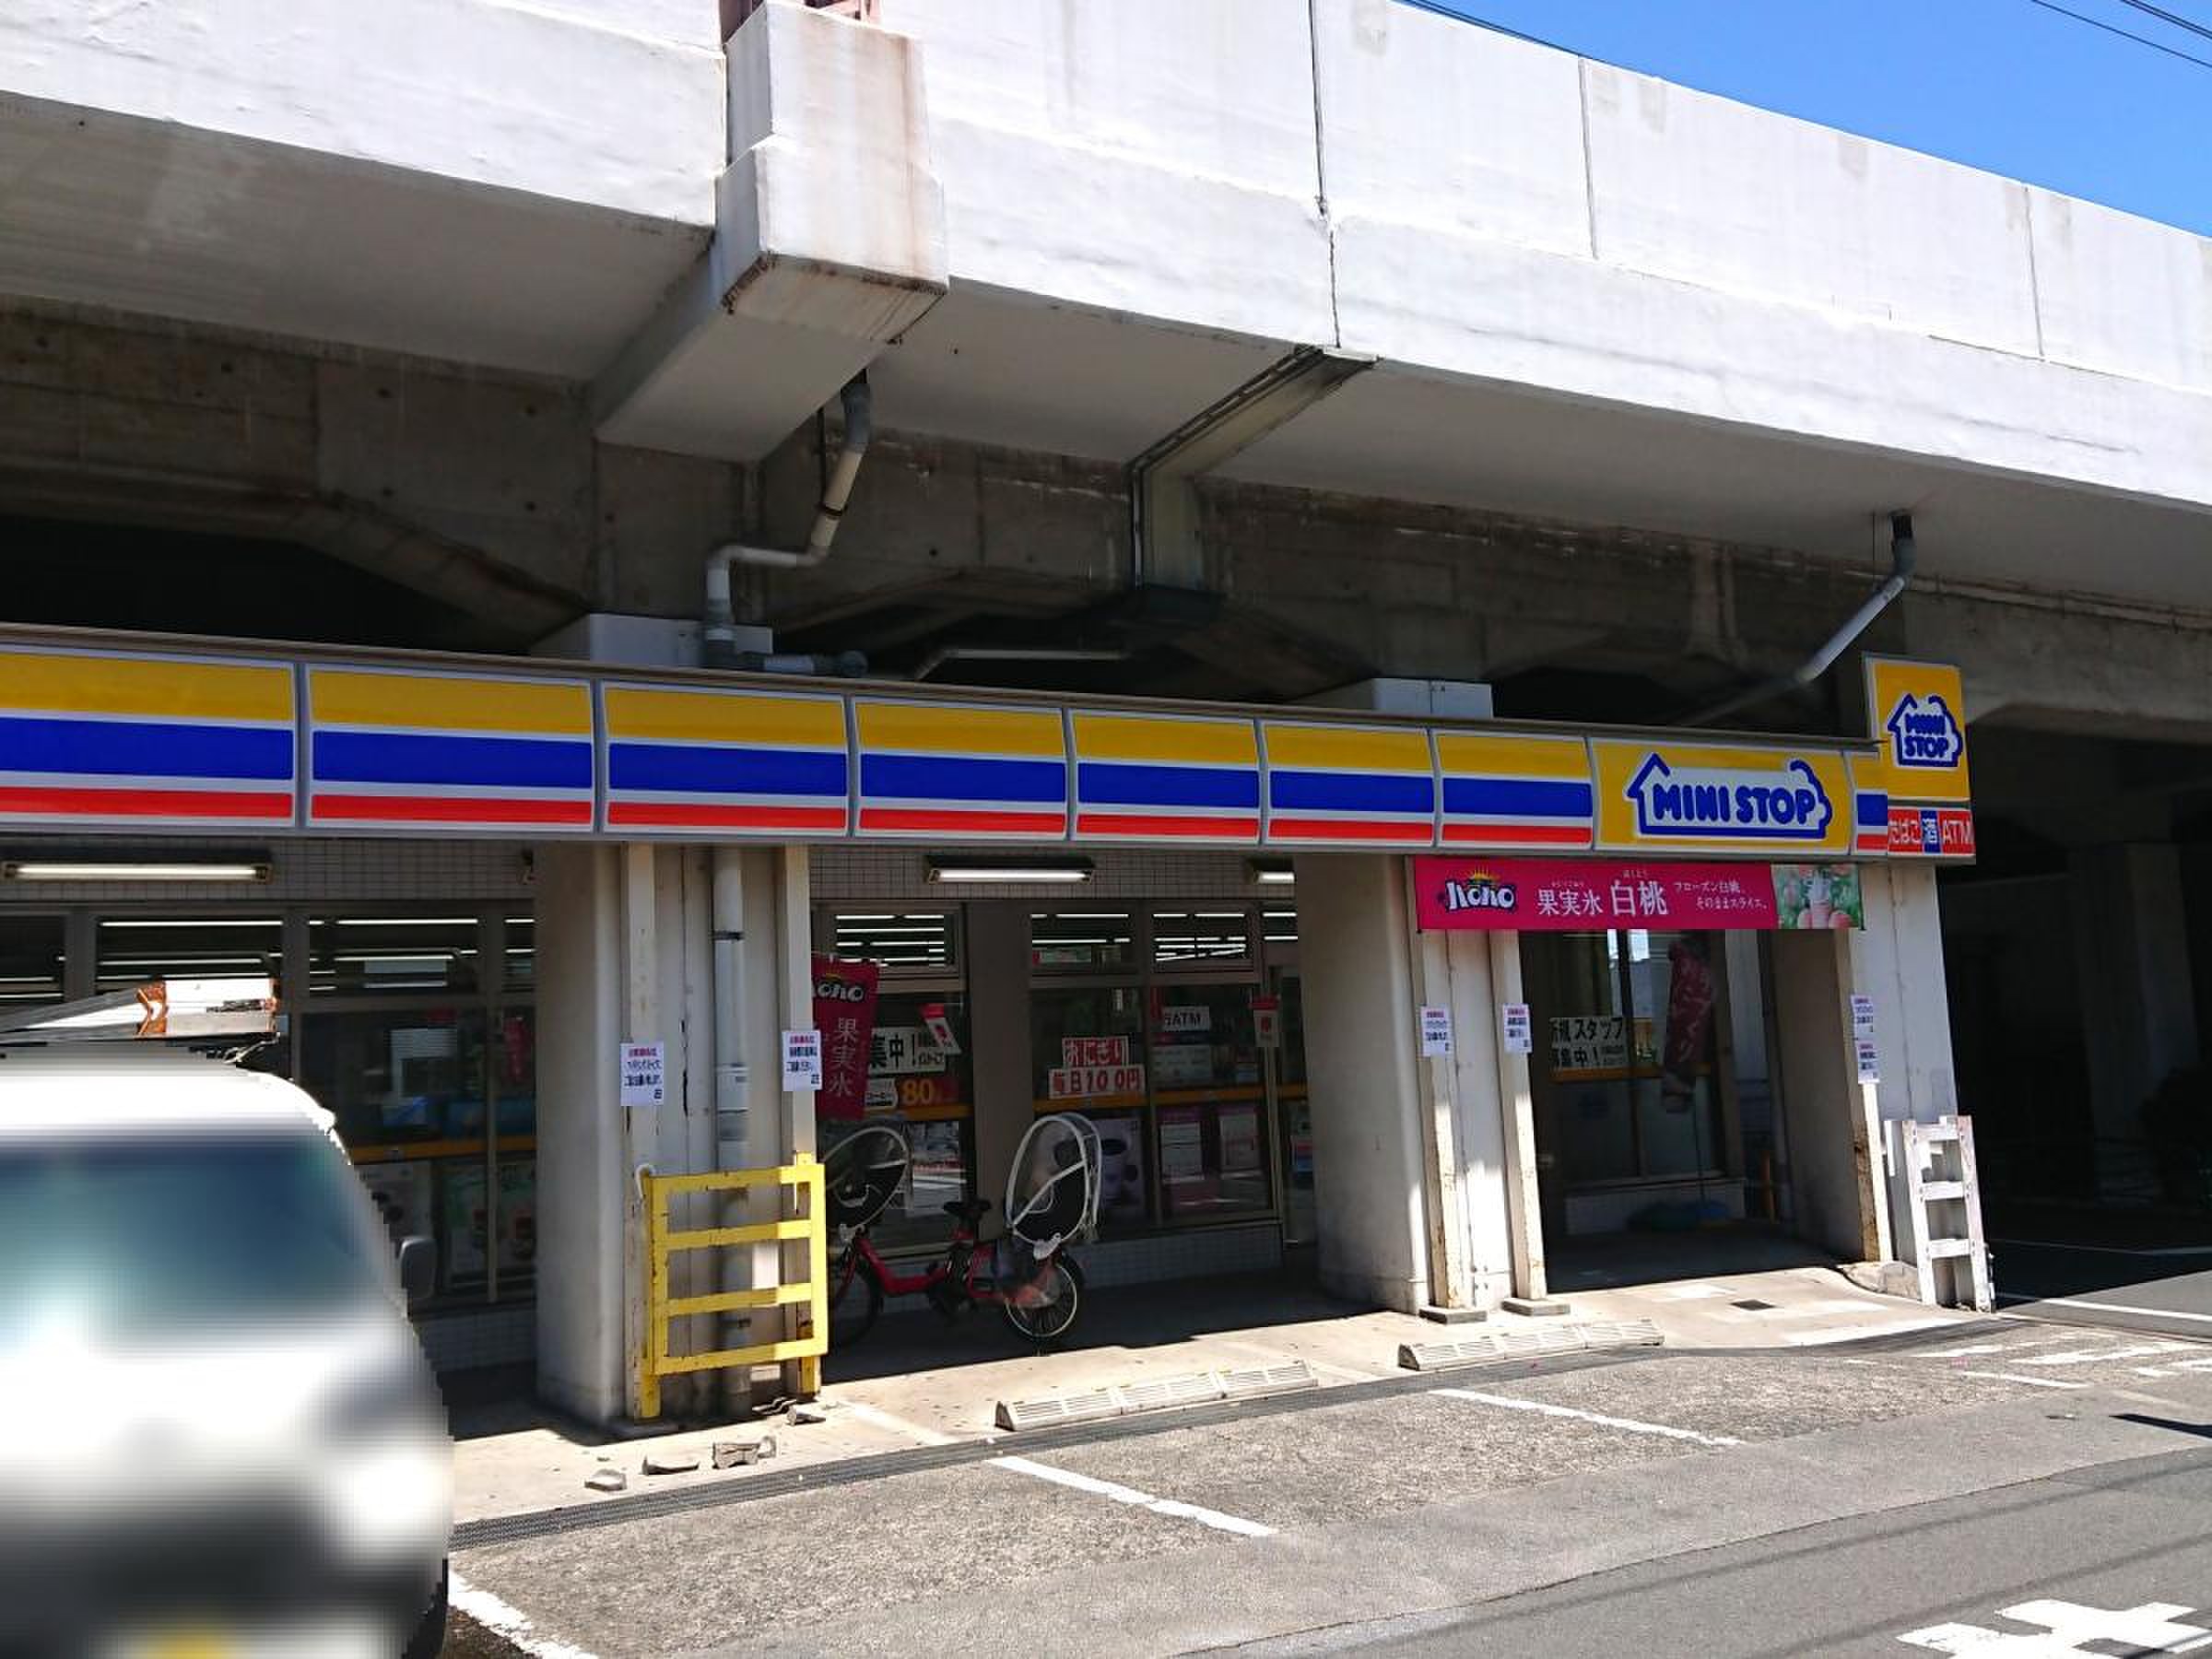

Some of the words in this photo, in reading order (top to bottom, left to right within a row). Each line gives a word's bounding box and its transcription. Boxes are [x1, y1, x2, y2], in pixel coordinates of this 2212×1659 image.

[1905, 713, 1946, 735] MINI
[1904, 735, 1948, 758] STOP
[1653, 783, 1730, 822] MINI
[1735, 785, 1816, 824] STOP
[1943, 819, 1974, 844] ATM
[1537, 888, 1604, 915] 果実氷
[1610, 879, 1668, 916] 白桃
